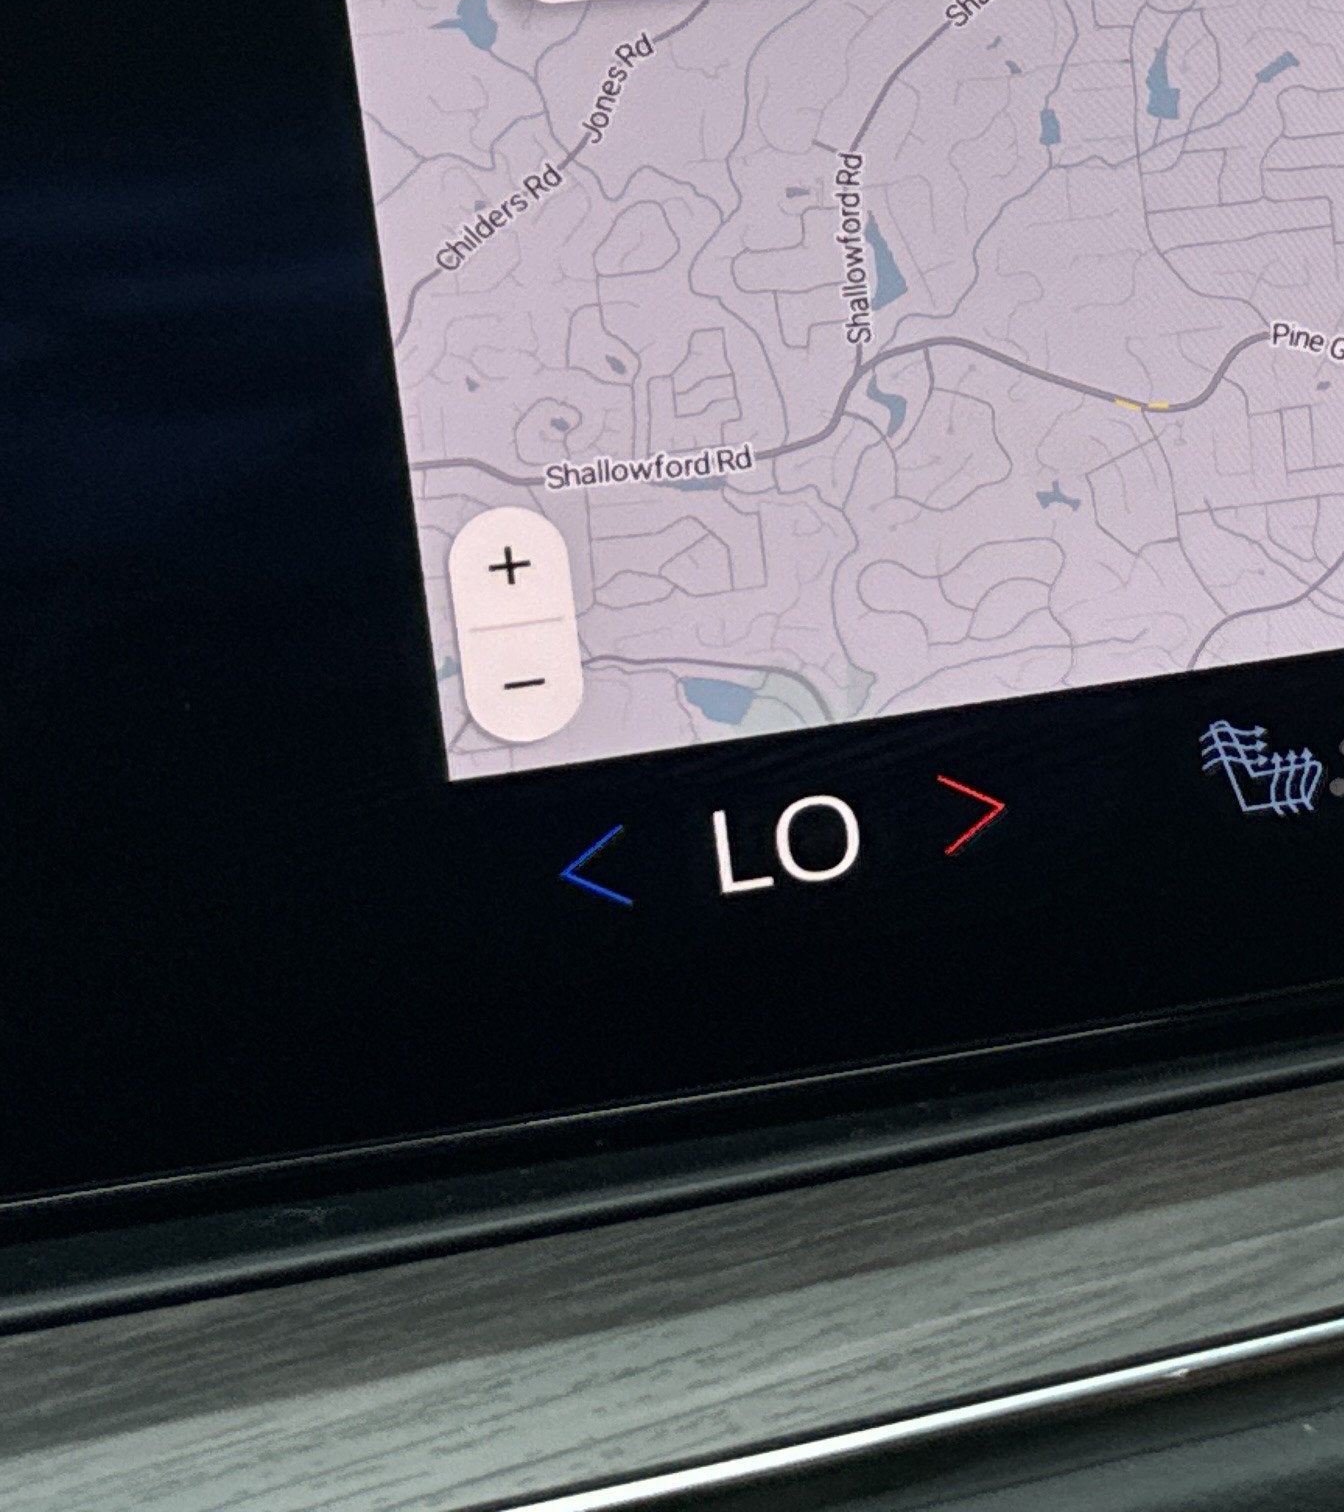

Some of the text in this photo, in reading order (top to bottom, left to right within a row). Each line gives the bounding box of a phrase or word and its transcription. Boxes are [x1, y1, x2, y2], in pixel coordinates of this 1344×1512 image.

[583, 34, 653, 144] Jones Rd
[437, 167, 563, 270] Childers Rd
[835, 152, 872, 344] Shallowford Rd
[1273, 324, 1324, 352] Pine
[546, 447, 752, 489] Shallowford Rd
[712, 795, 861, 896] LO
